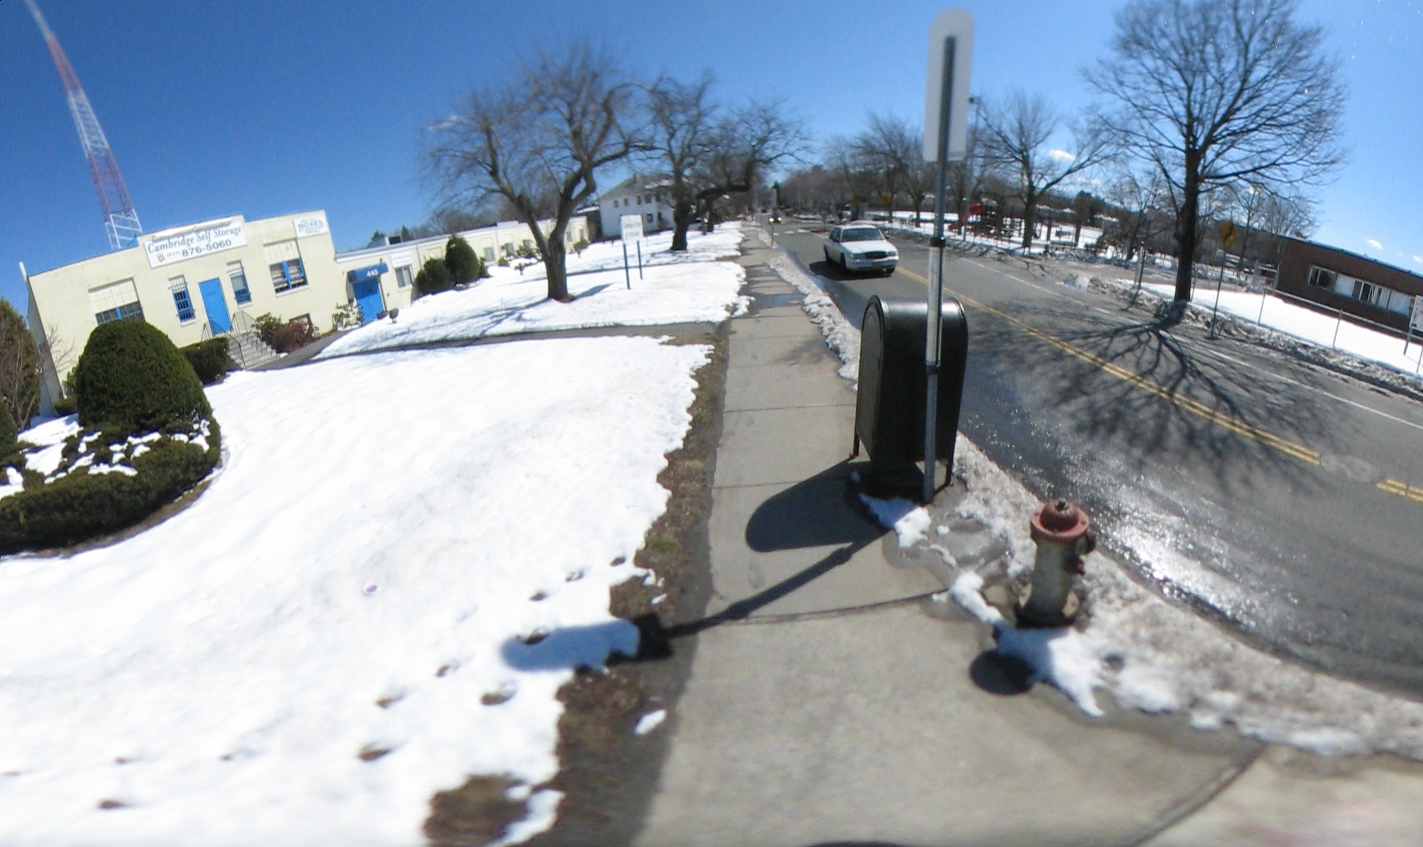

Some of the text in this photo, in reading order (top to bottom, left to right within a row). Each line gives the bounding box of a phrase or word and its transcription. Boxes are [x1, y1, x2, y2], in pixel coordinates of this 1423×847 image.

[148, 225, 242, 253] Cambridge Self Storage
[182, 239, 232, 257] 876-5060
